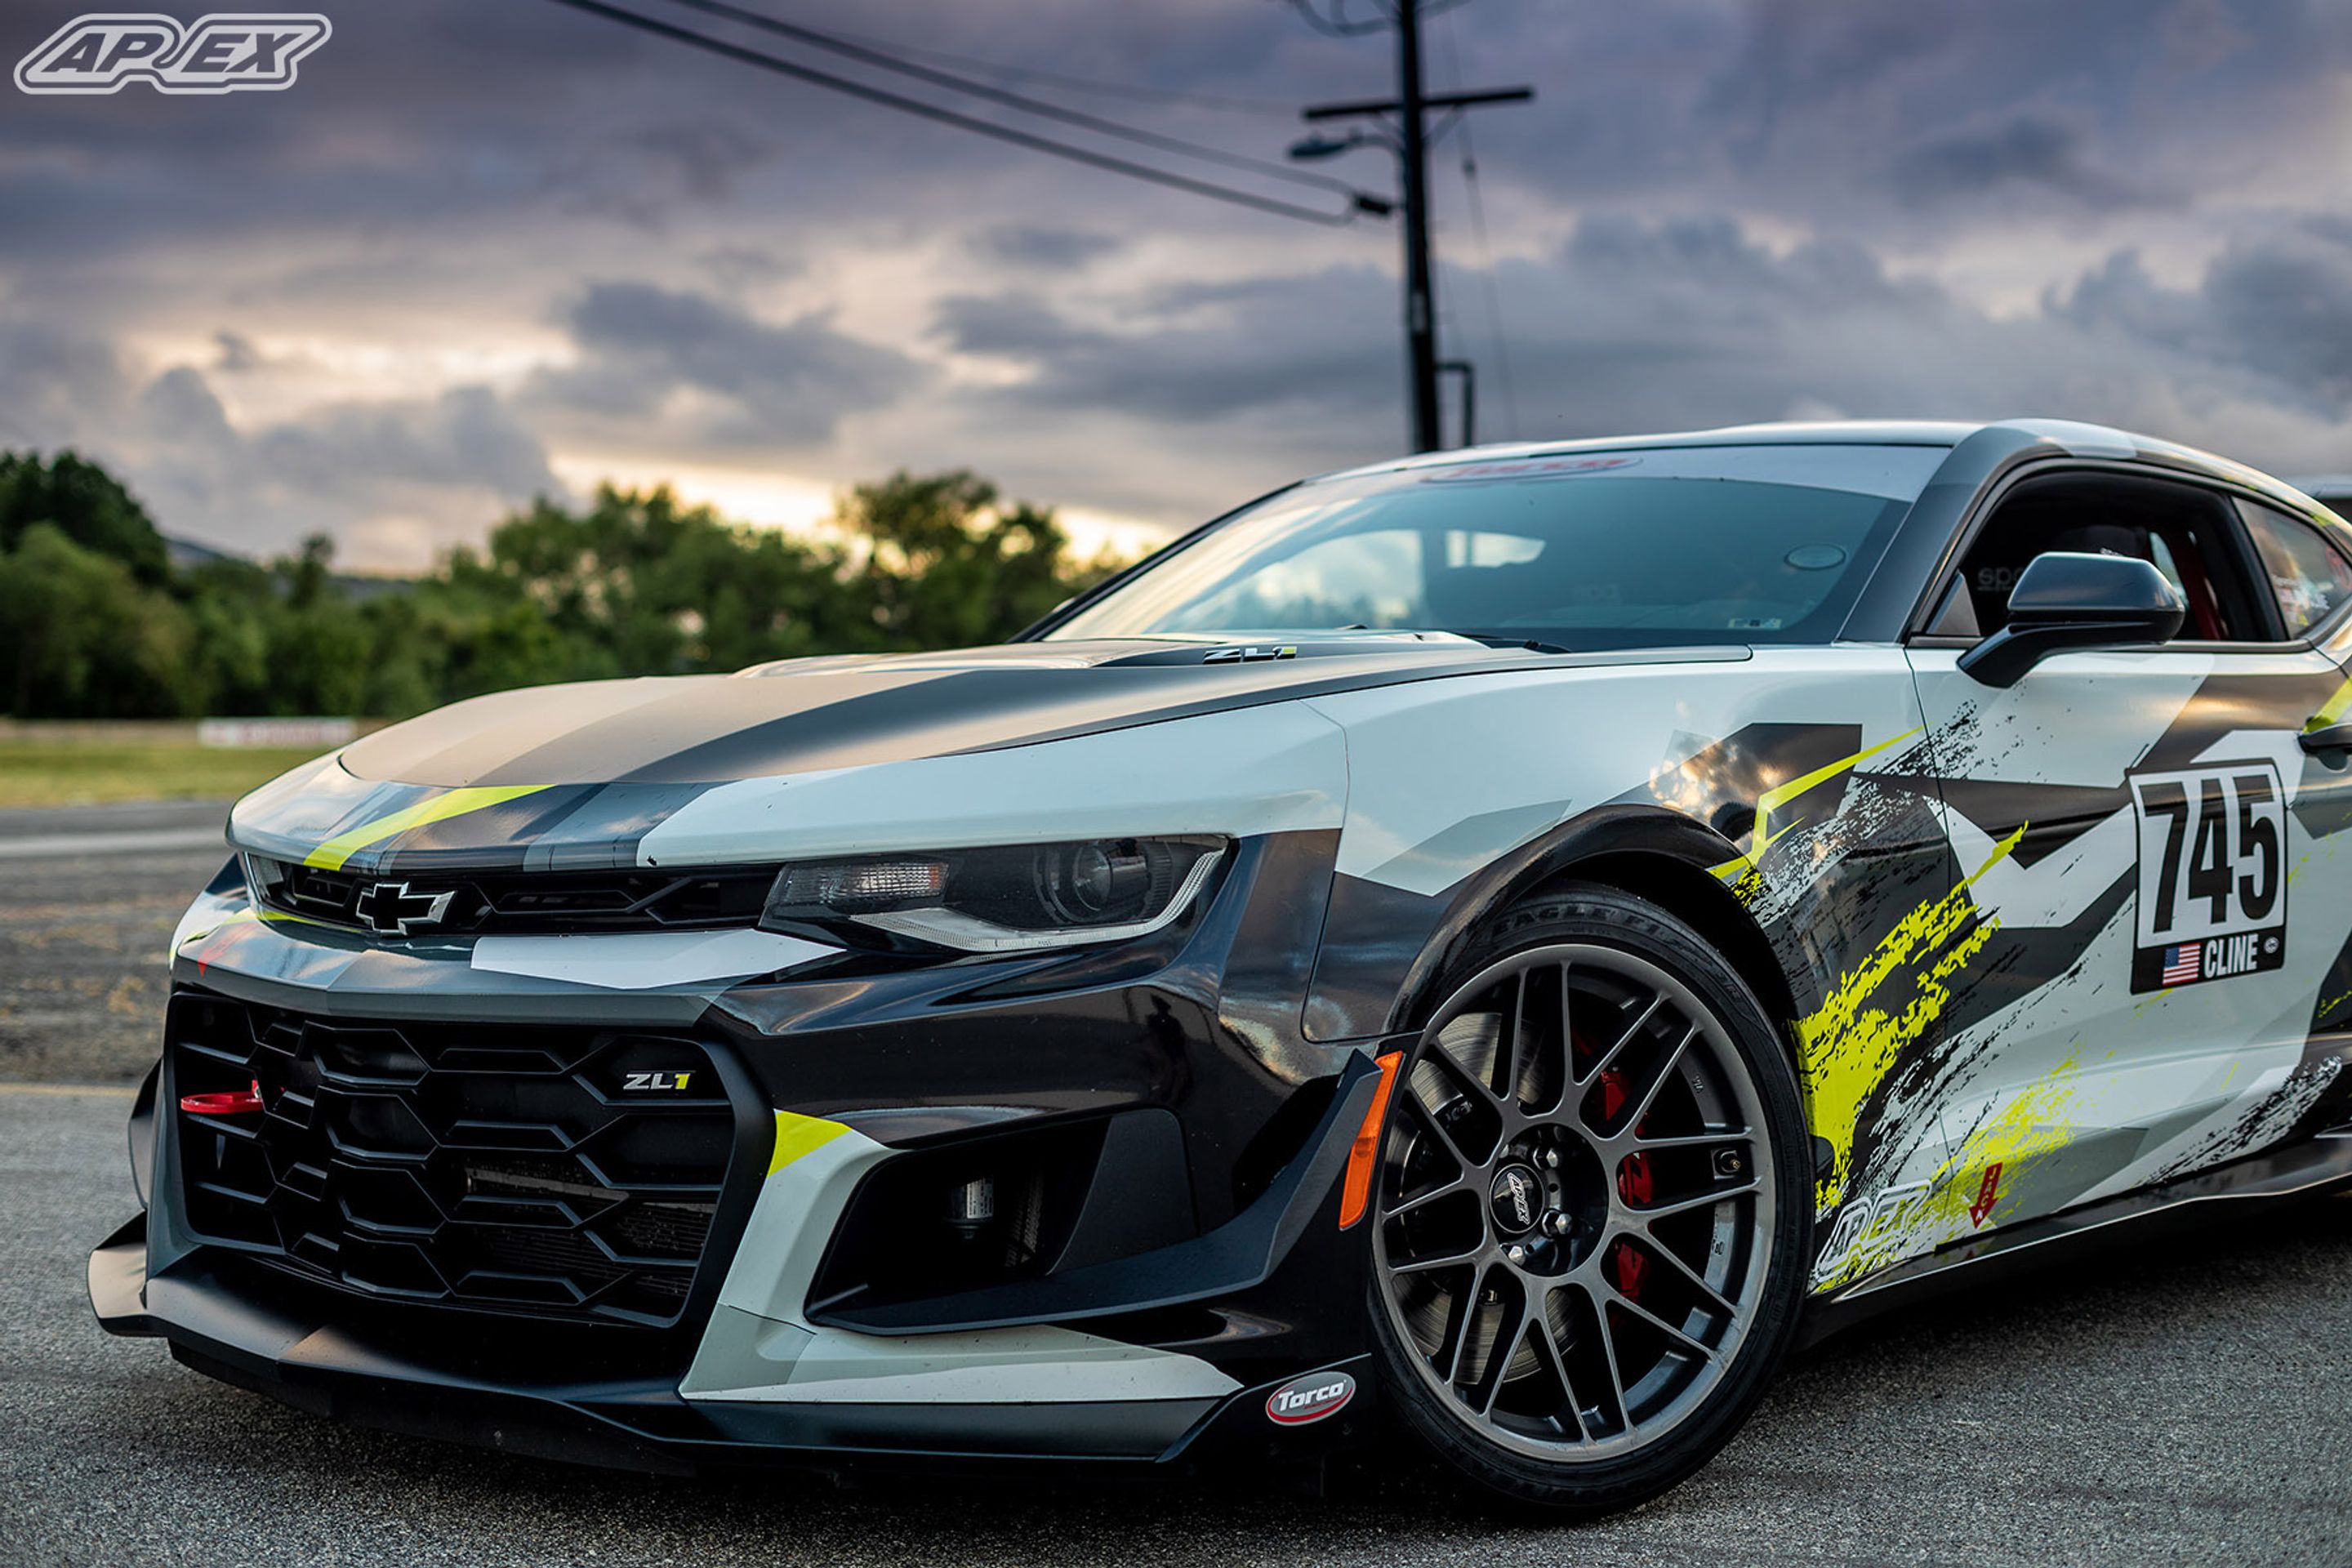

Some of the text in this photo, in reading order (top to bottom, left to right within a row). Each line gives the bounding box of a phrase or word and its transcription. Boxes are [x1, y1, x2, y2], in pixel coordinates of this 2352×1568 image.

[1202, 645, 1298, 665] ZL1
[2137, 773, 2279, 934] 745
[1492, 904, 1611, 938] EAGLE
[2203, 933, 2260, 979] CLINE
[622, 1073, 692, 1090] ZL1
[1278, 1381, 1345, 1412] Torco
